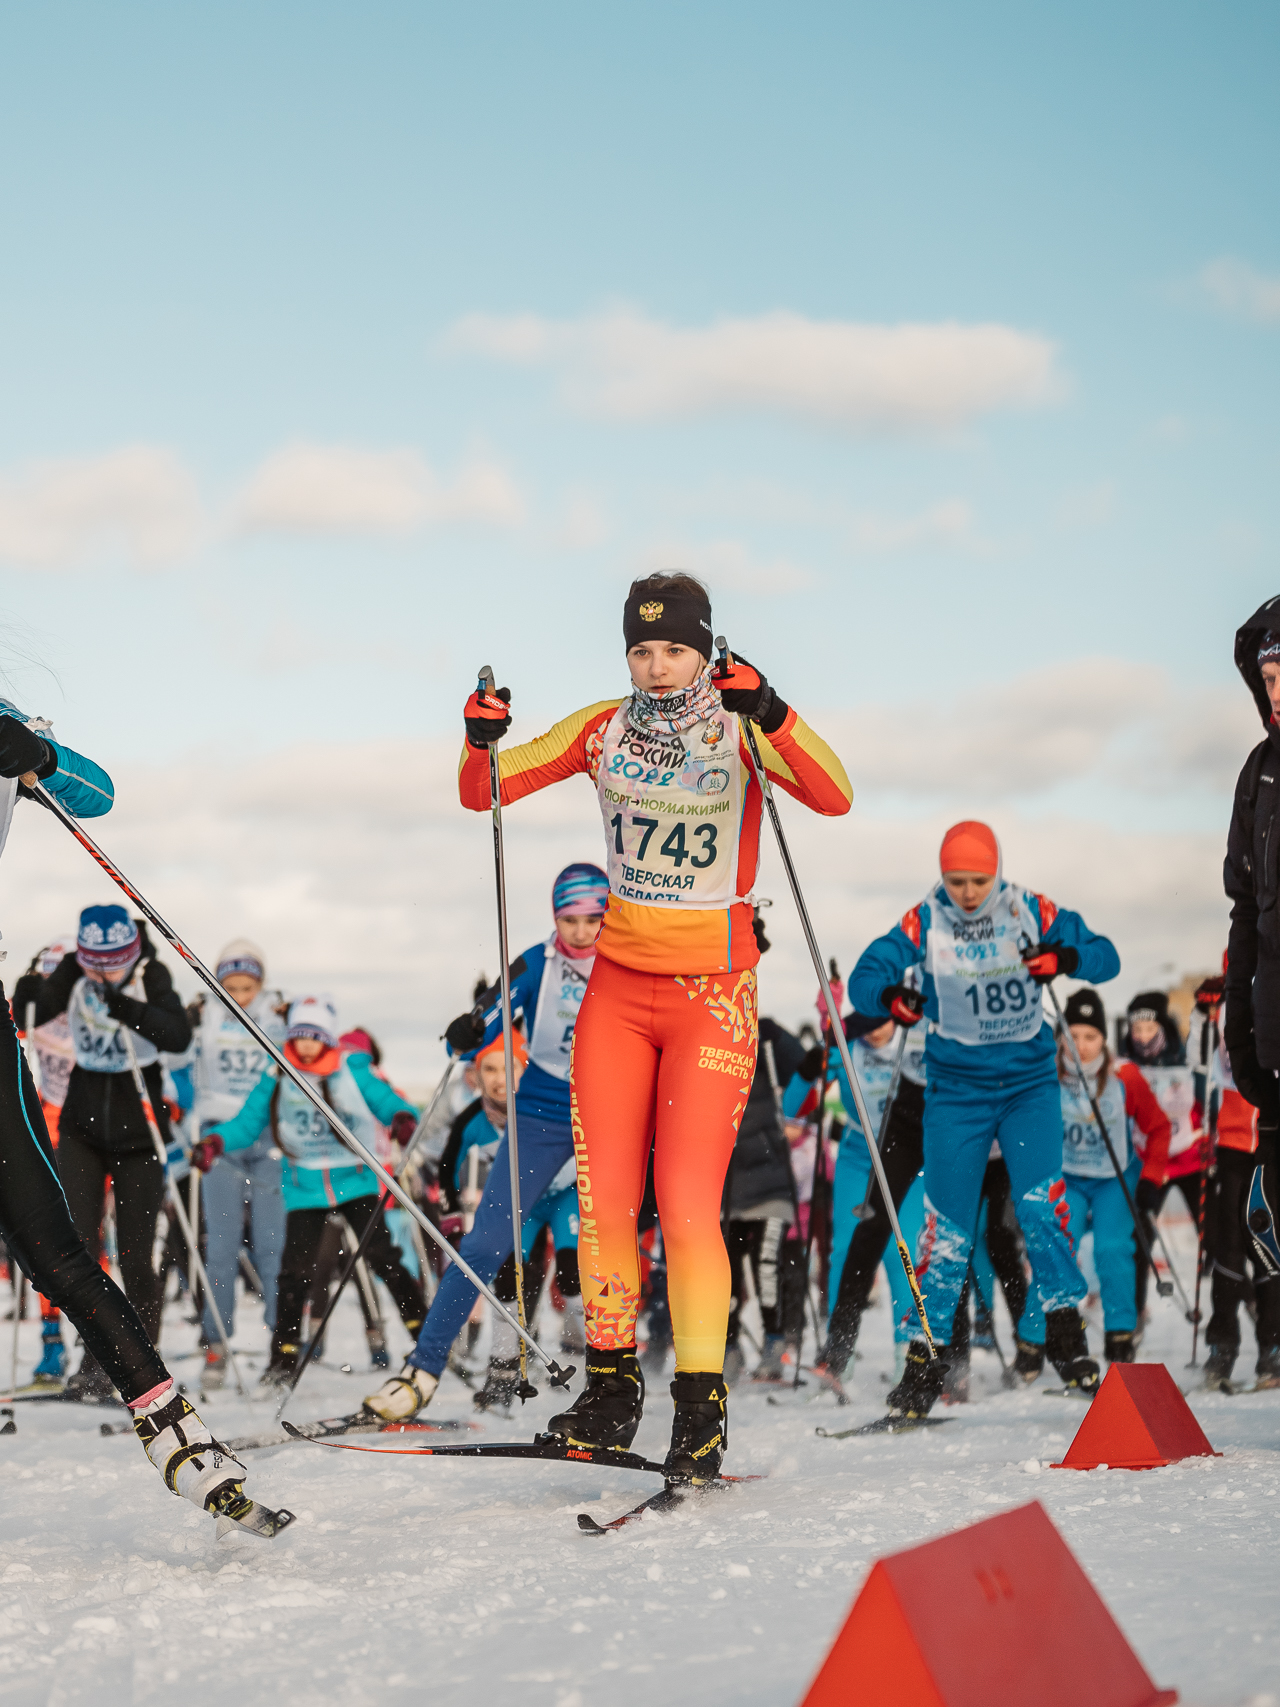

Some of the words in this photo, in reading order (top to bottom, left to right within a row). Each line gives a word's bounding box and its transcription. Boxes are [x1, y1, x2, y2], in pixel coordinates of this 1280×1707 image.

[617, 732, 687, 769] РОССИИ
[608, 753, 675, 787] 2022
[604, 788, 633, 807] СПОРТ
[640, 797, 686, 816] НОРМА
[686, 799, 730, 816] ЖИЗНИ
[610, 812, 719, 869] 1743
[621, 863, 696, 891] ТВЕРСКАЯ
[697, 1057, 749, 1080] ОБЛАСТЬ
[699, 1045, 754, 1070] ТВЕРСКАЯ
[566, 1449, 593, 1461] ATOMIC
[691, 1433, 722, 1461] FISCHER
